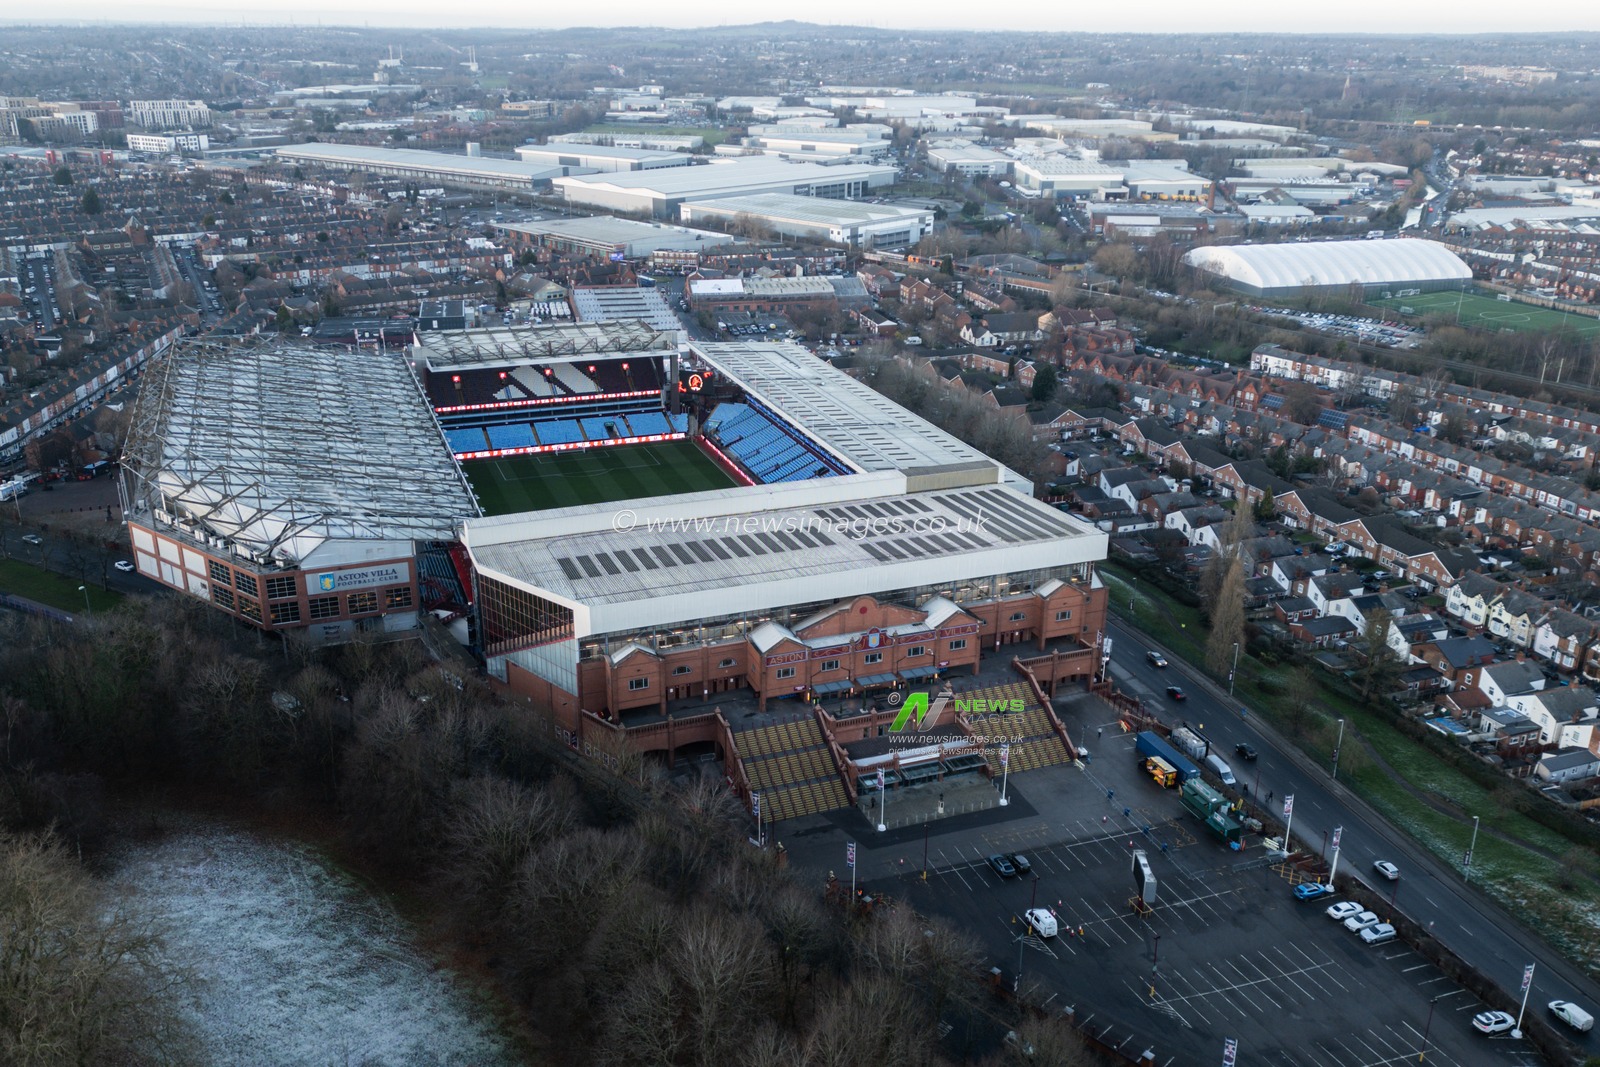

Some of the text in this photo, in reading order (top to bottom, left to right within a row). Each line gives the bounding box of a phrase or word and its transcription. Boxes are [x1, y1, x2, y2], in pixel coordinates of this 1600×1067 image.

[338, 572, 369, 581] ASTON
[370, 569, 397, 577] VILLA
[770, 626, 973, 665] ASTON VILLA
